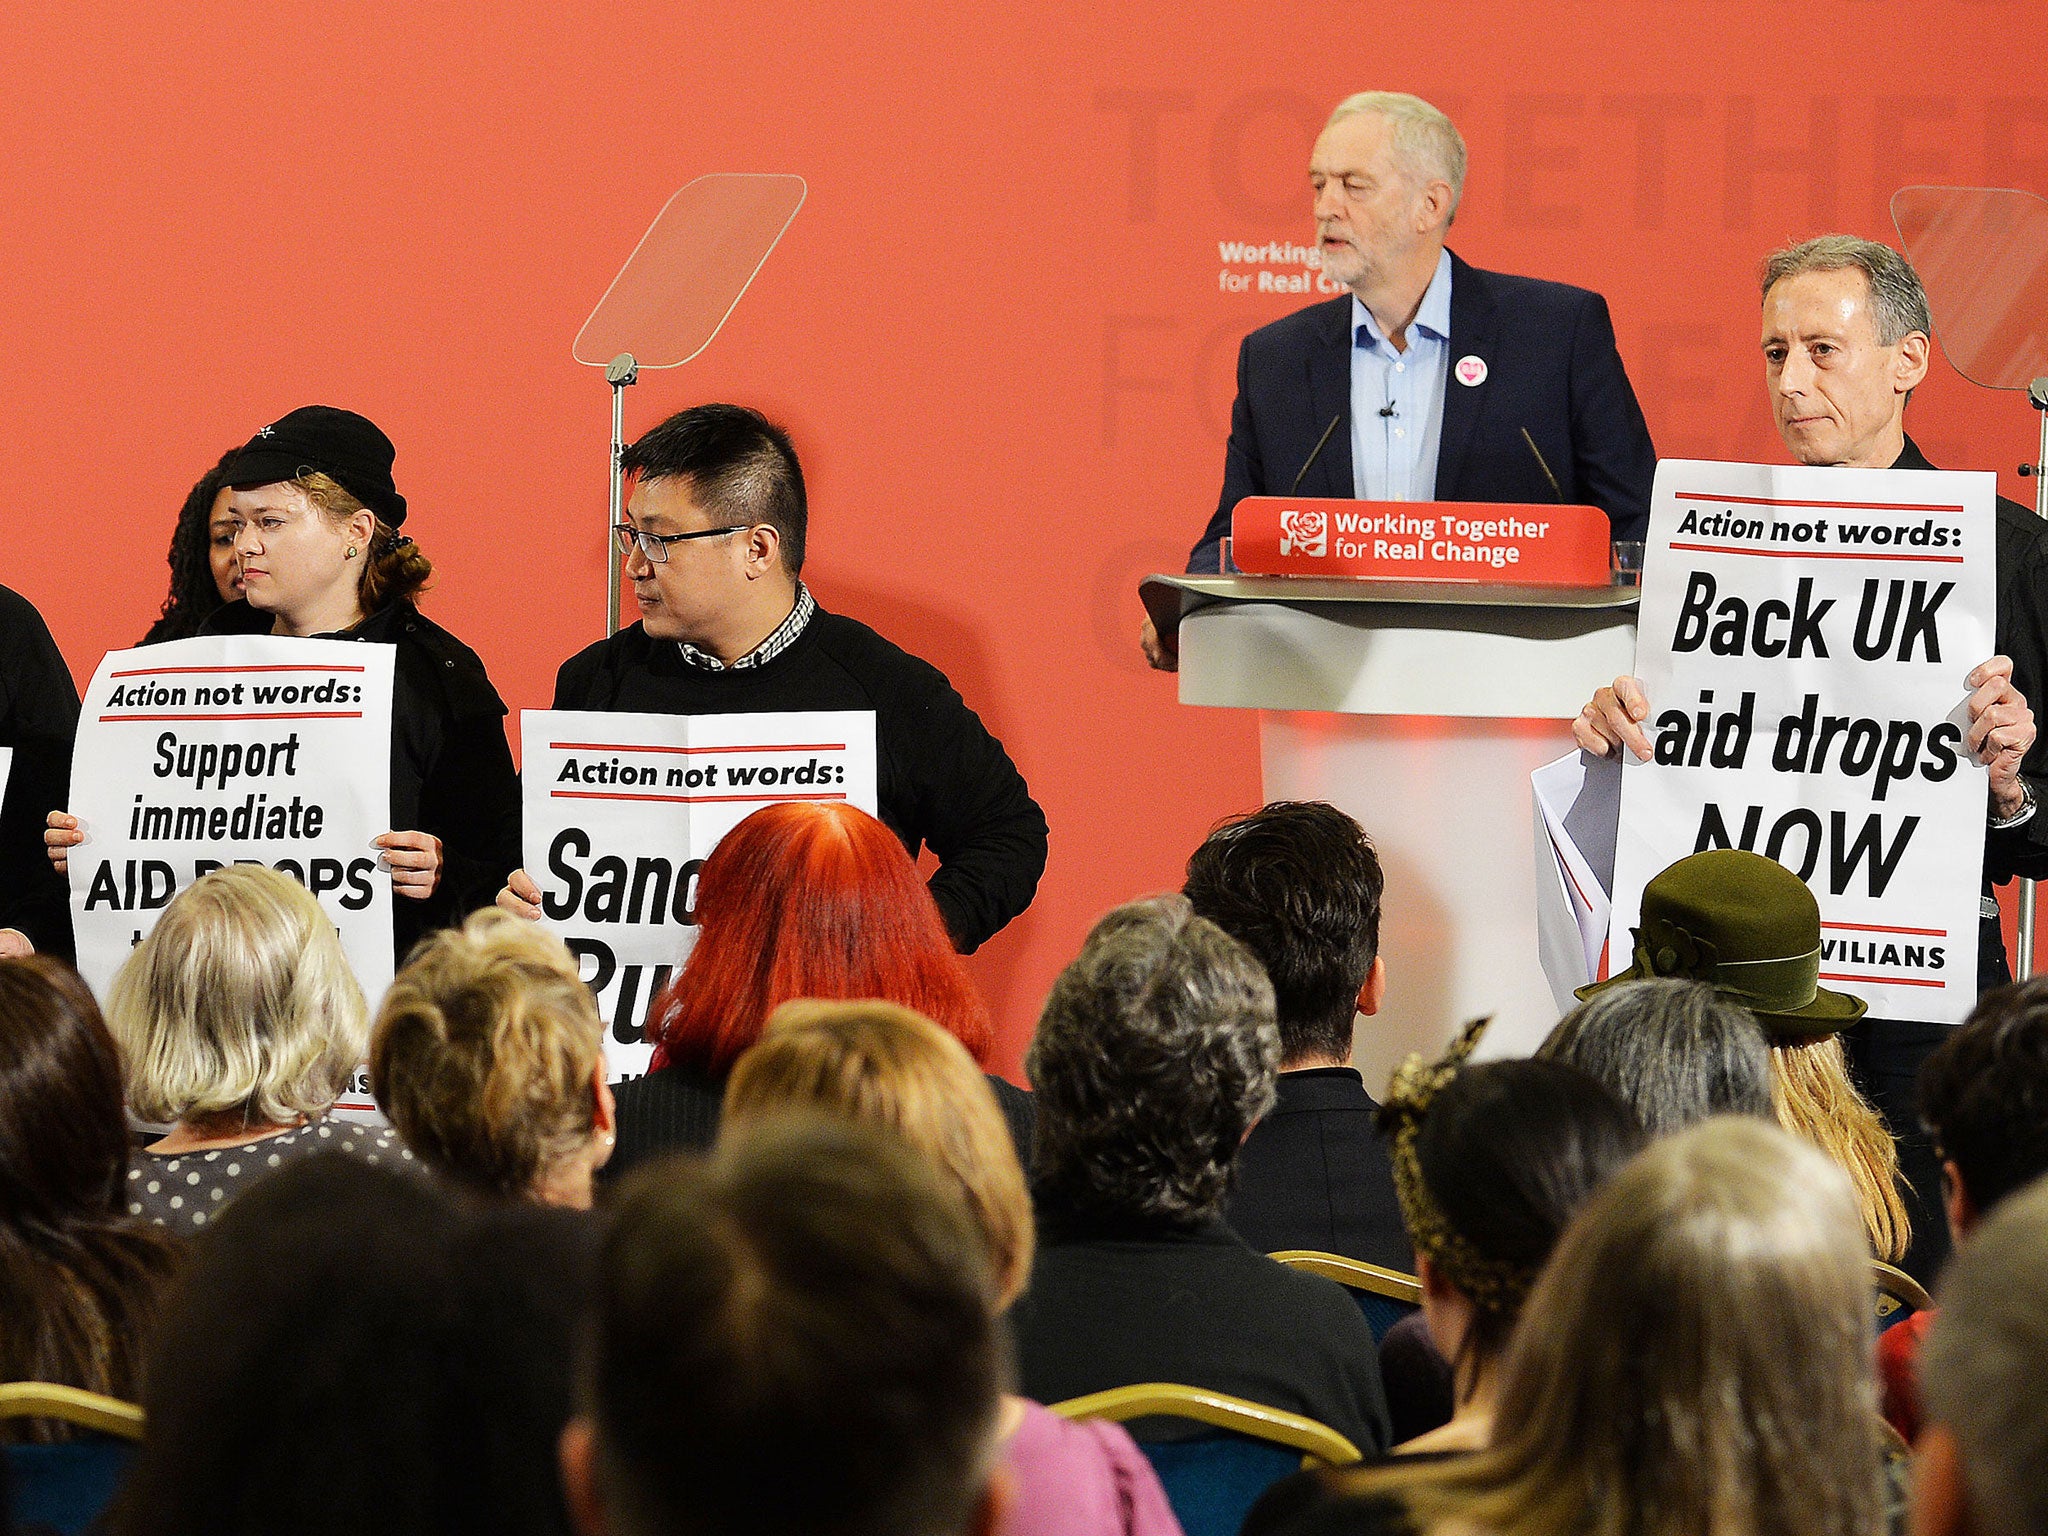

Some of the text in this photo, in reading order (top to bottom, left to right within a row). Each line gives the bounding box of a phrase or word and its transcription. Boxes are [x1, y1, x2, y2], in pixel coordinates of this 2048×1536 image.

[1219, 269, 1252, 291] for
[1258, 271, 1311, 293] Real
[1335, 512, 1550, 542] Working Together
[1677, 509, 1962, 547] Action not words:
[1335, 537, 1520, 568] for Real Change
[1671, 570, 1957, 664] Back UK
[105, 678, 362, 708] Action not words:
[153, 731, 300, 791] Support
[1653, 689, 1962, 802] aid drops
[556, 757, 844, 789] Action not words:
[129, 793, 324, 841] immediate
[1690, 802, 1922, 899] NOW
[83, 858, 177, 911] AID
